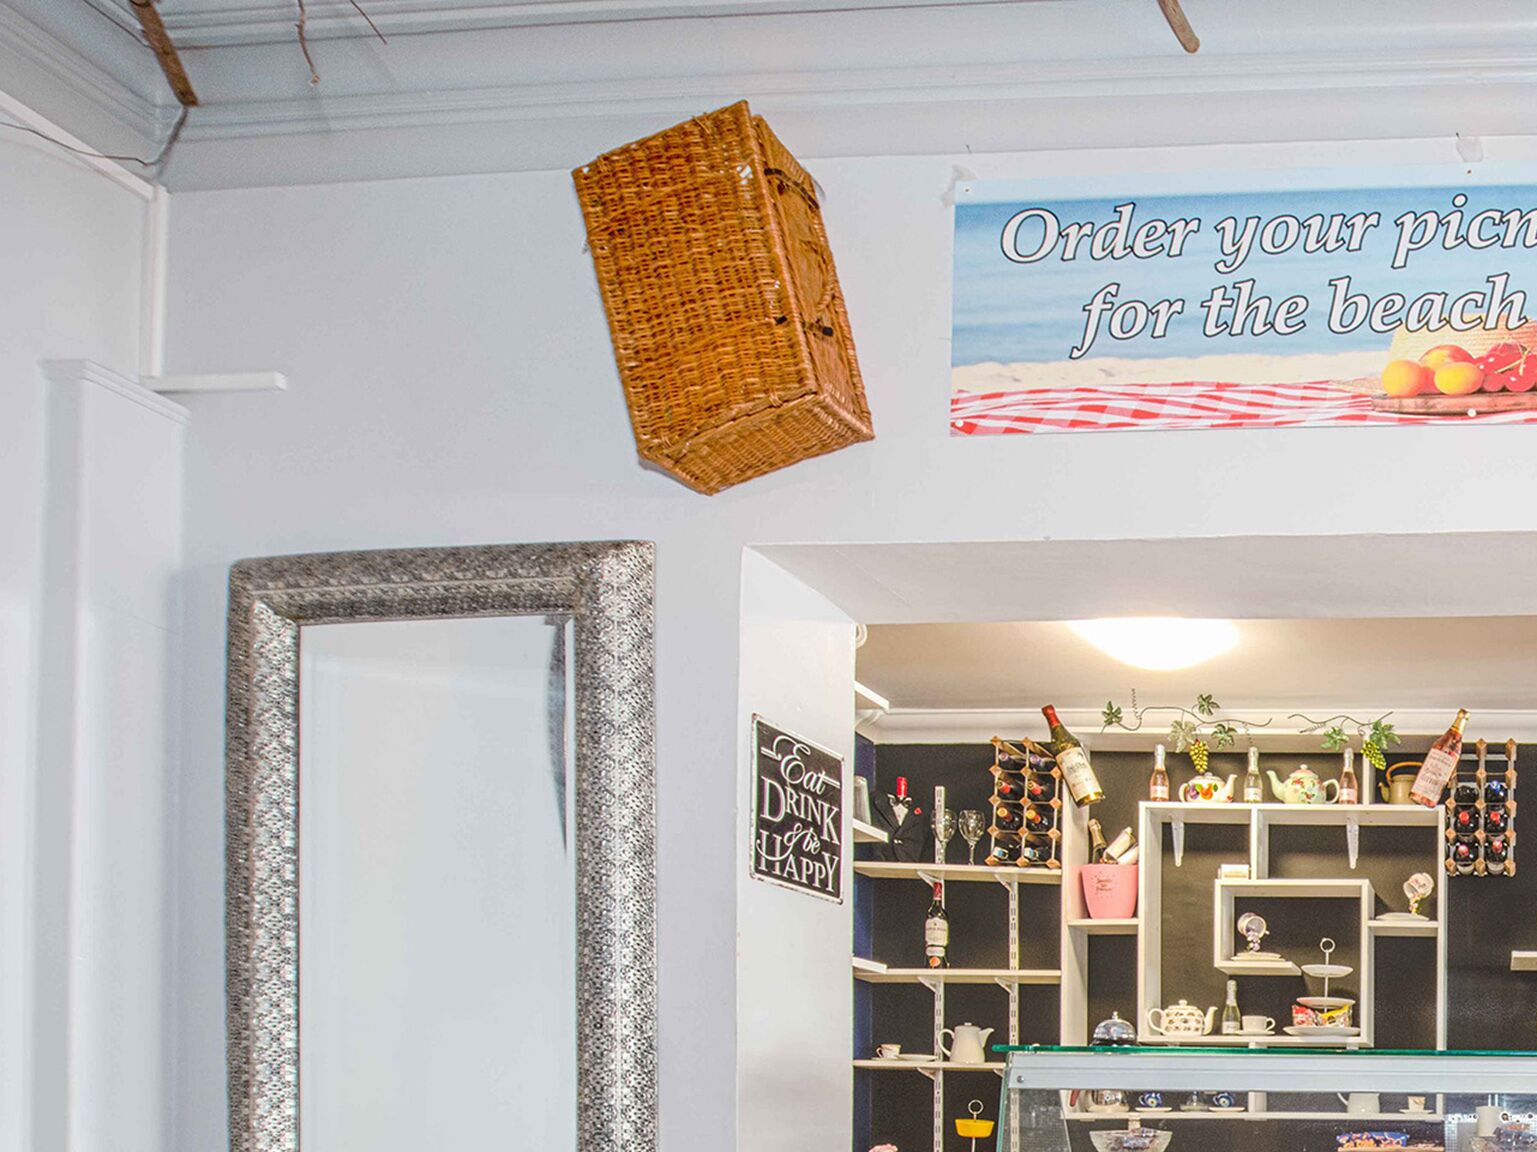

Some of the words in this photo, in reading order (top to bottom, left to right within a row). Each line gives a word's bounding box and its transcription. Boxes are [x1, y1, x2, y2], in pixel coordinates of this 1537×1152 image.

[1000, 202, 1201, 264] Order
[1214, 211, 1381, 275] your
[1069, 282, 1185, 360] for
[1200, 278, 1308, 338] the
[1327, 272, 1528, 335] beach
[761, 735, 841, 796] Eat
[760, 775, 841, 846] DRINK
[757, 829, 840, 893] HAPPY
